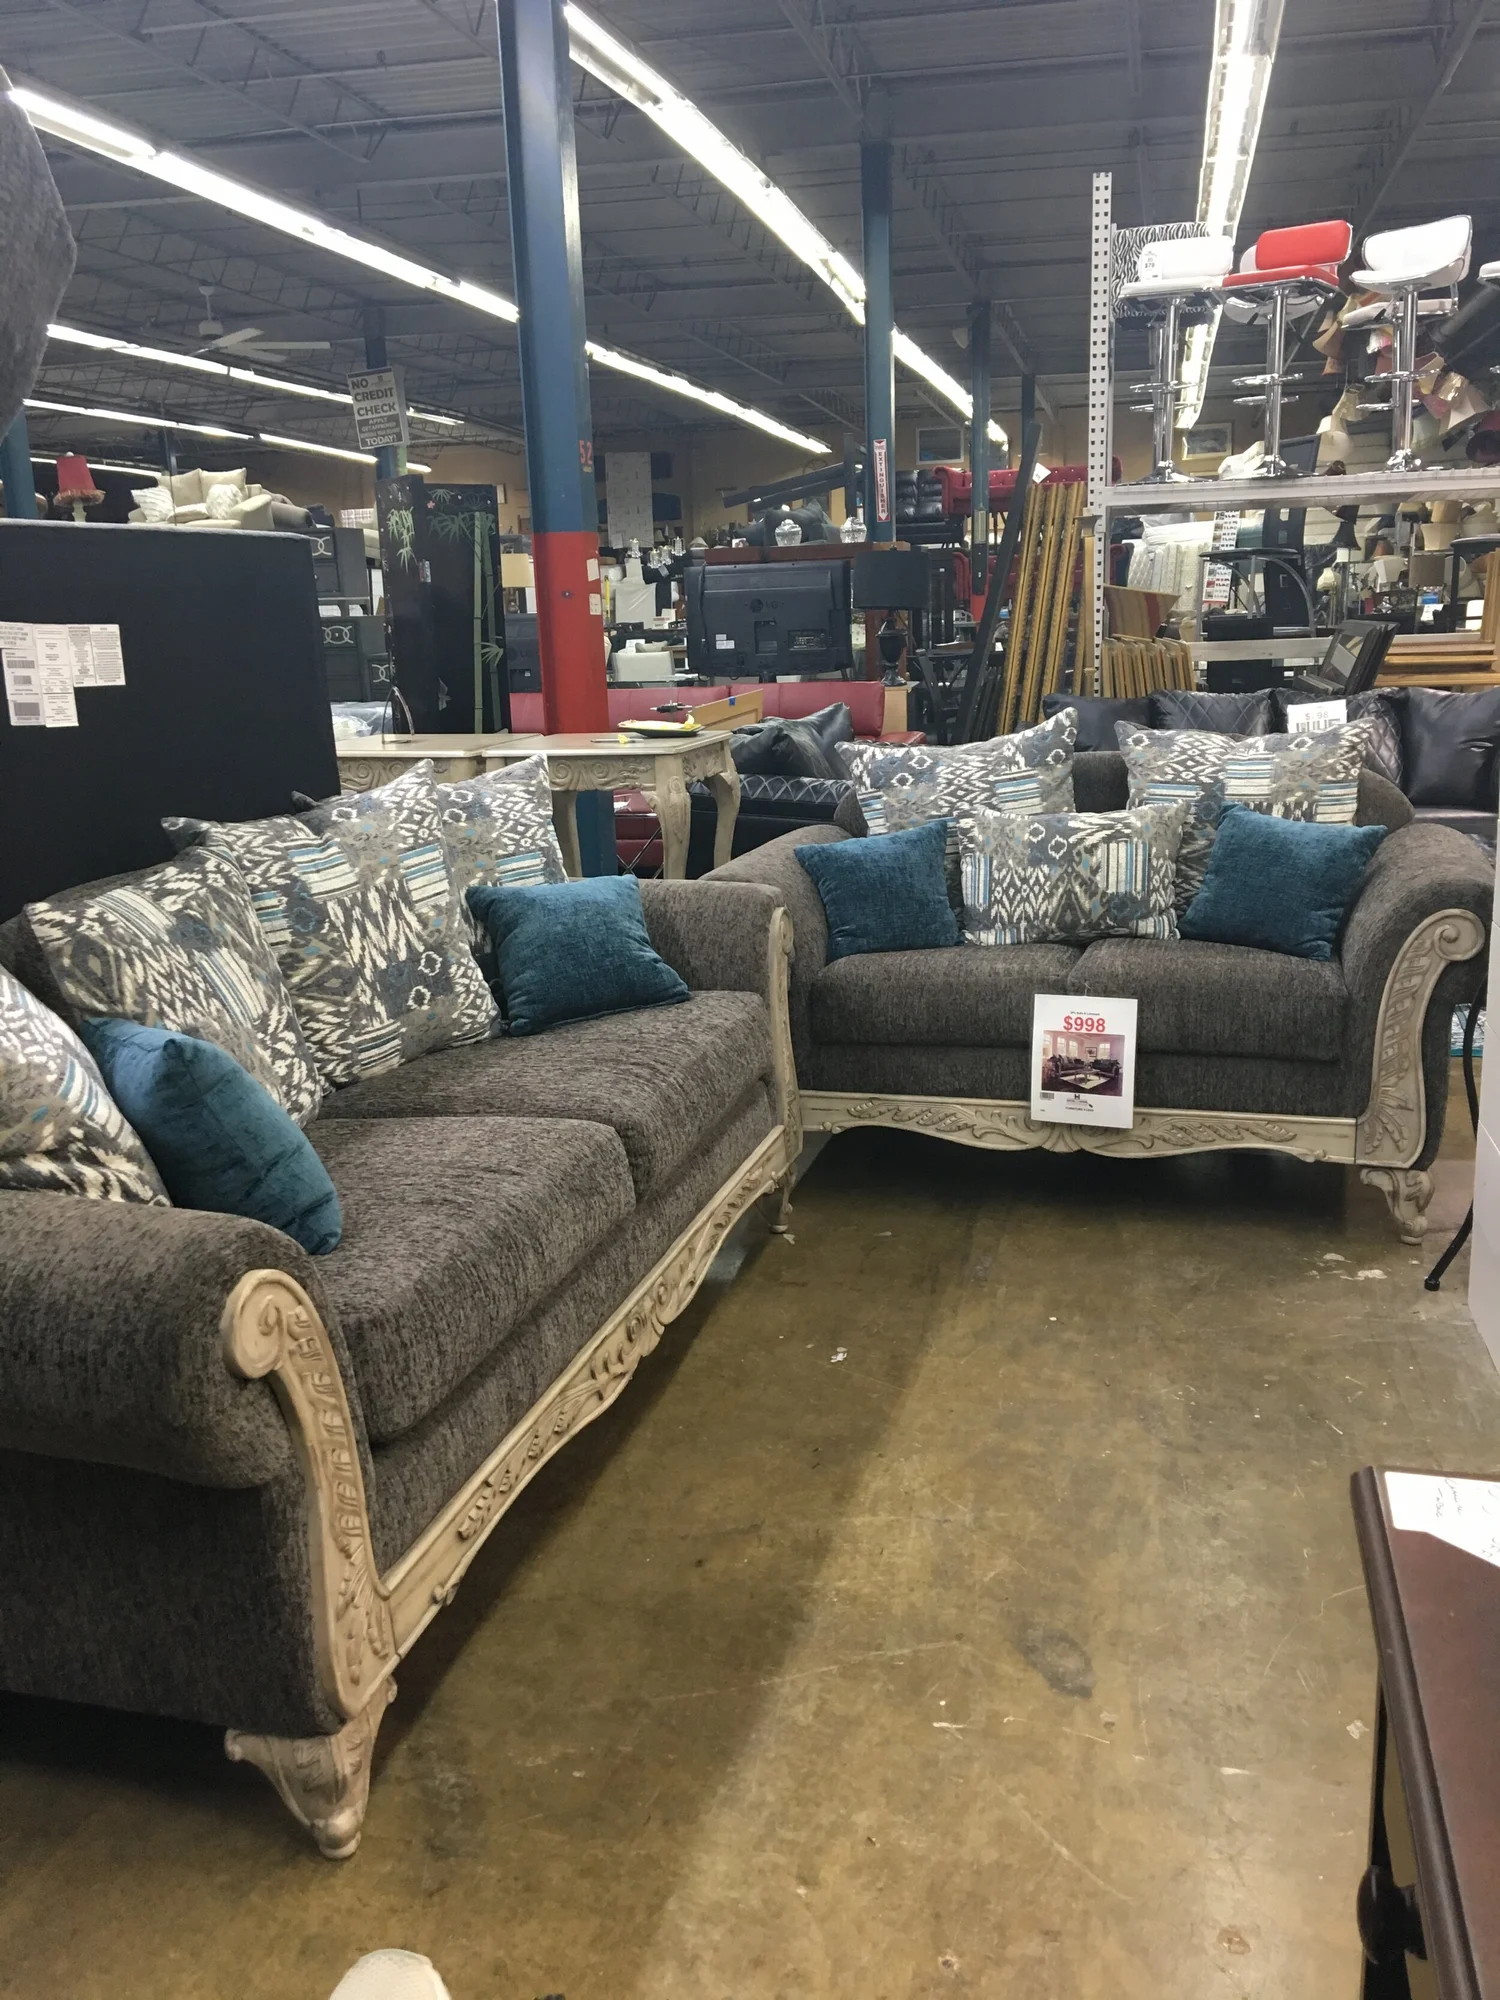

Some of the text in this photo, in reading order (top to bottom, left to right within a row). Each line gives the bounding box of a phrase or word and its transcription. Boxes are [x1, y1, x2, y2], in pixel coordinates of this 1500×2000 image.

[351, 378, 368, 390] NO
[354, 387, 393, 402] CREDIT
[357, 403, 396, 417] CHECK
[368, 417, 388, 425] APPLY
[365, 434, 397, 446] TODAY!
[579, 440, 592, 464] 52
[878, 451, 886, 513] EXTINGUISHER
[1063, 1015, 1105, 1033] $998
